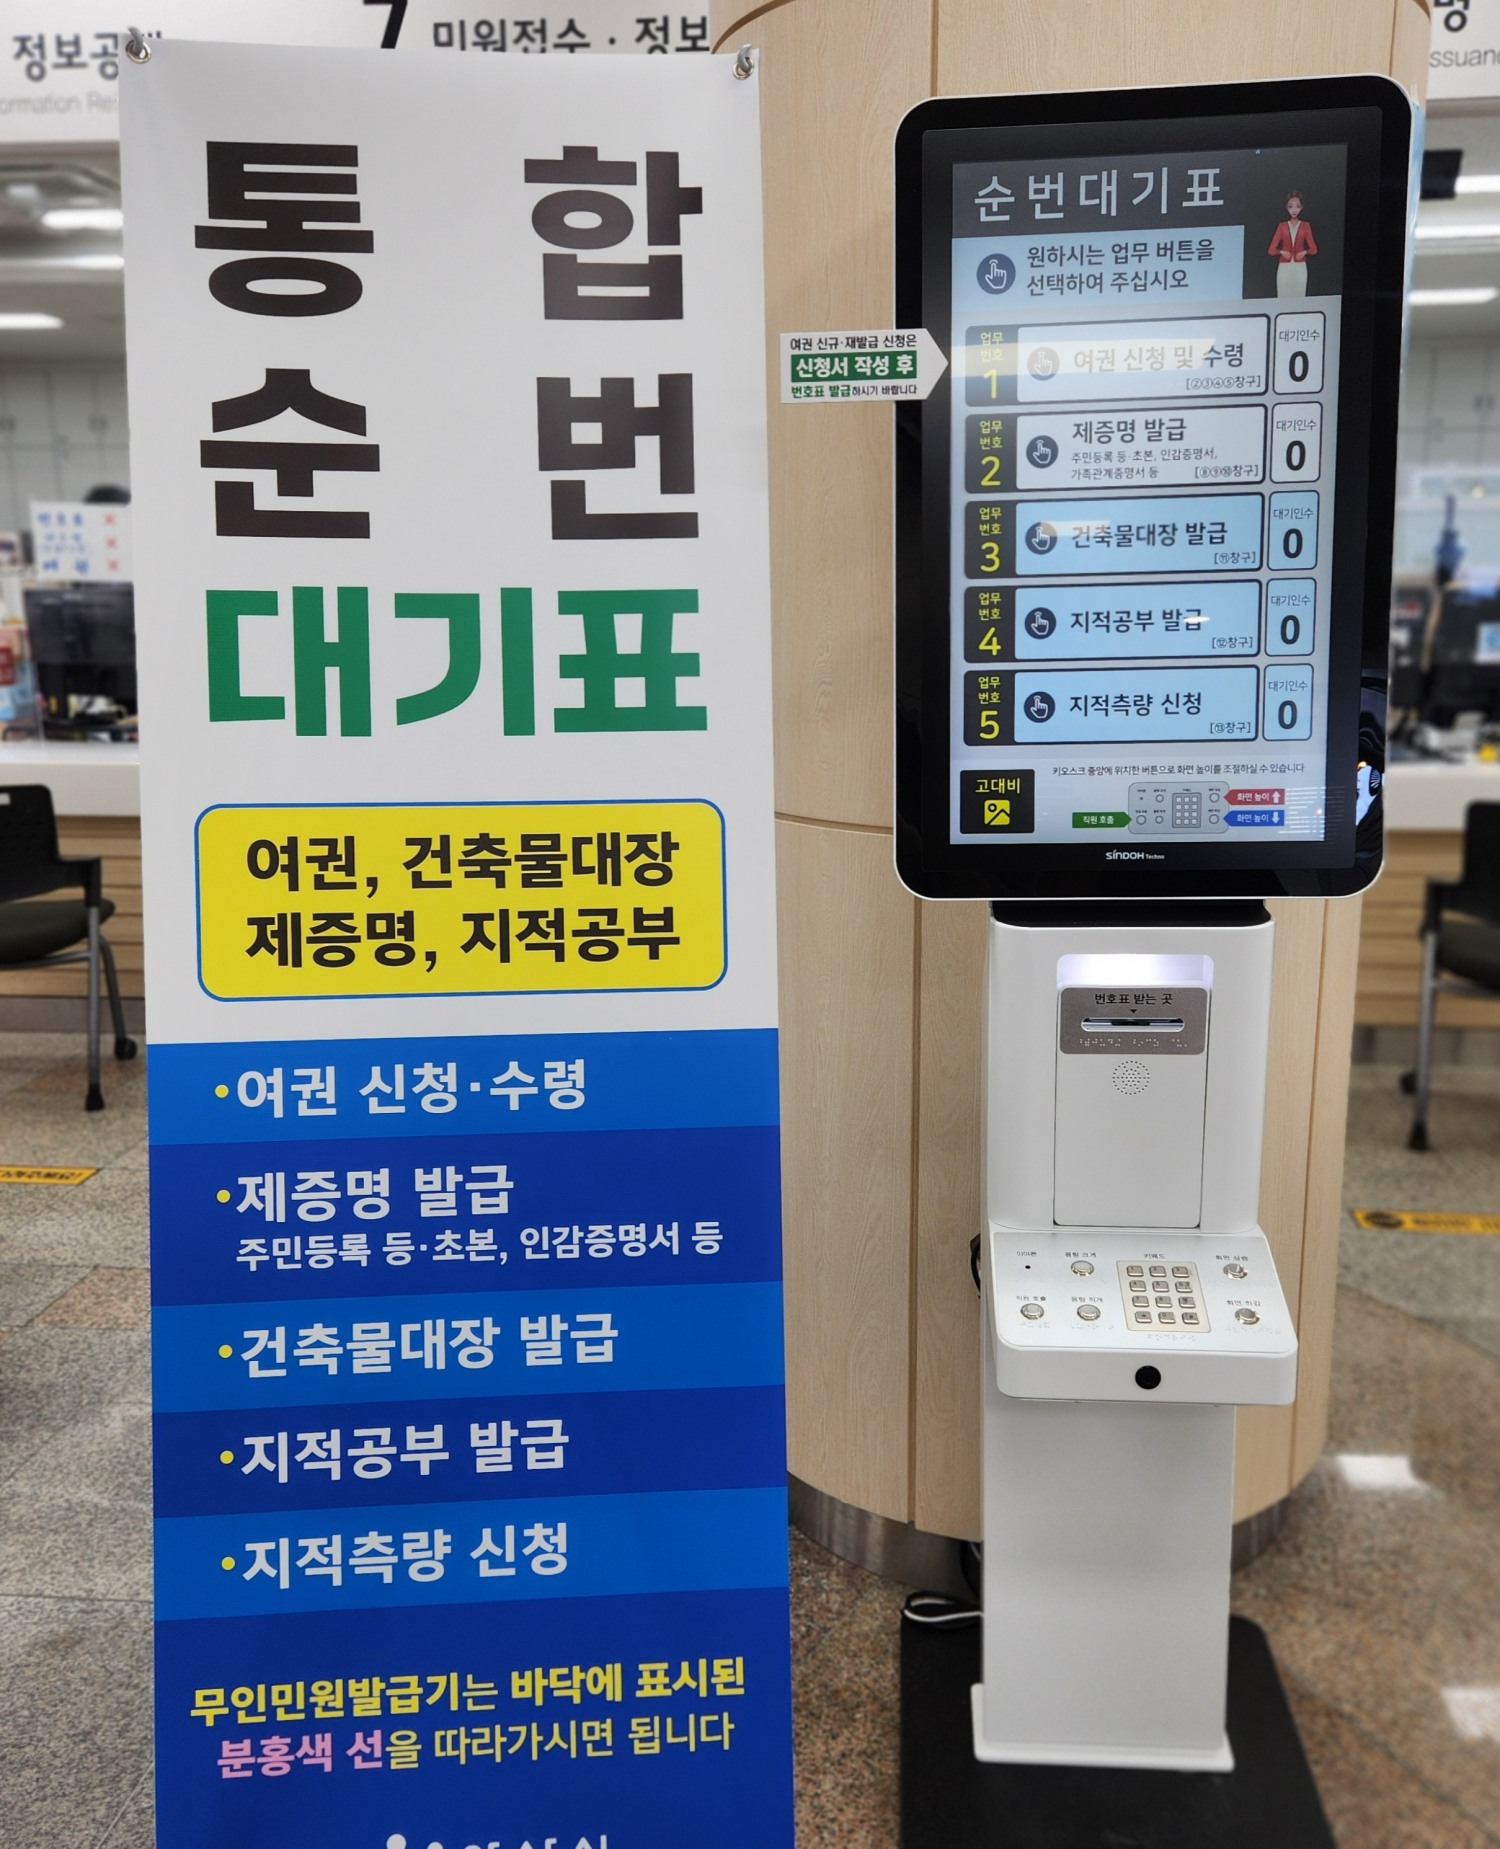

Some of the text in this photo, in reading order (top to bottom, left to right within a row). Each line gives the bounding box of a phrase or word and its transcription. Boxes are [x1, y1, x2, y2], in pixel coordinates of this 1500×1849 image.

[13, 31, 161, 82] 정보공
[974, 166, 1225, 223] 순번대기표
[1027, 238, 1215, 268] 원하시는 업무 버튼을
[1027, 269, 1189, 296] 선택하여 주십시오
[790, 337, 813, 351] 여권
[883, 334, 917, 348] 신청은
[980, 331, 1004, 346] 업무
[1279, 329, 1320, 342] 대기인수
[796, 354, 914, 378] 신청서 작성 후
[980, 346, 1004, 362] 번호
[1074, 342, 1244, 374] 여권 신청 및 수령
[1288, 350, 1309, 382] 0
[791, 384, 917, 398] 번호표 발급하시기 바랍니다
[982, 368, 998, 399] 1
[979, 420, 1003, 434] 업무
[1072, 417, 1187, 445] 제증명 발급
[1276, 418, 1317, 432] 대기인수
[979, 435, 1003, 450] 번호
[1071, 450, 1114, 464] 주민등록
[1160, 447, 1218, 461] 인감증명서,
[1285, 440, 1307, 471] 0
[980, 455, 1001, 487] 2
[1071, 466, 1159, 480] 가족관계증명서 등
[979, 507, 1002, 521] 업무
[1273, 507, 1314, 520] 대기인수
[978, 521, 1002, 536] 번호
[1071, 521, 1228, 549] 건축물대장 발급
[1282, 528, 1303, 559] 0
[980, 541, 1001, 573] 3
[978, 592, 1001, 606] 업무
[1270, 594, 1311, 607] 대기인수
[978, 607, 1001, 621] 번호
[1070, 608, 1203, 634] 지적공부 발급
[978, 627, 1001, 656] 4
[1280, 614, 1301, 645] 0
[206, 586, 708, 737] 대기표
[978, 676, 1001, 690] 업무
[1268, 679, 1309, 692] 대기인수
[978, 690, 1001, 704] 번호
[1069, 692, 1202, 718] 지적측량 신청
[978, 710, 1000, 740] 5
[1277, 700, 1298, 730] 0
[1052, 762, 1305, 776] 키오스크 중앙에 위치한 버튼으로 화면 높이를 조절하실 수 있습니다
[975, 777, 1021, 794] 고대비
[1237, 792, 1270, 802] 화면 높이
[1082, 815, 1097, 825] 직원
[1236, 813, 1269, 823] 화면 높이
[246, 831, 680, 899] 여권, 건축물대장
[246, 906, 681, 973] 제증명, 지적공부
[1094, 993, 1173, 1005] 번호표 받는 곳
[237, 1065, 338, 1119] 여권
[236, 1165, 515, 1223] 제증명 발급
[236, 1231, 372, 1272] 주민등록
[520, 1222, 681, 1261] 인감증명서
[691, 1220, 724, 1255] 등
[240, 1313, 619, 1378] 건축물대장 발급
[241, 1419, 570, 1484] 지적공부 발급
[242, 1522, 569, 1589] 지적측량 신청
[190, 1656, 746, 1726] 무인민원발급기는 바닥에 표시된
[217, 1711, 735, 1779] 분홍색 선을 따라가시면 됩니다
